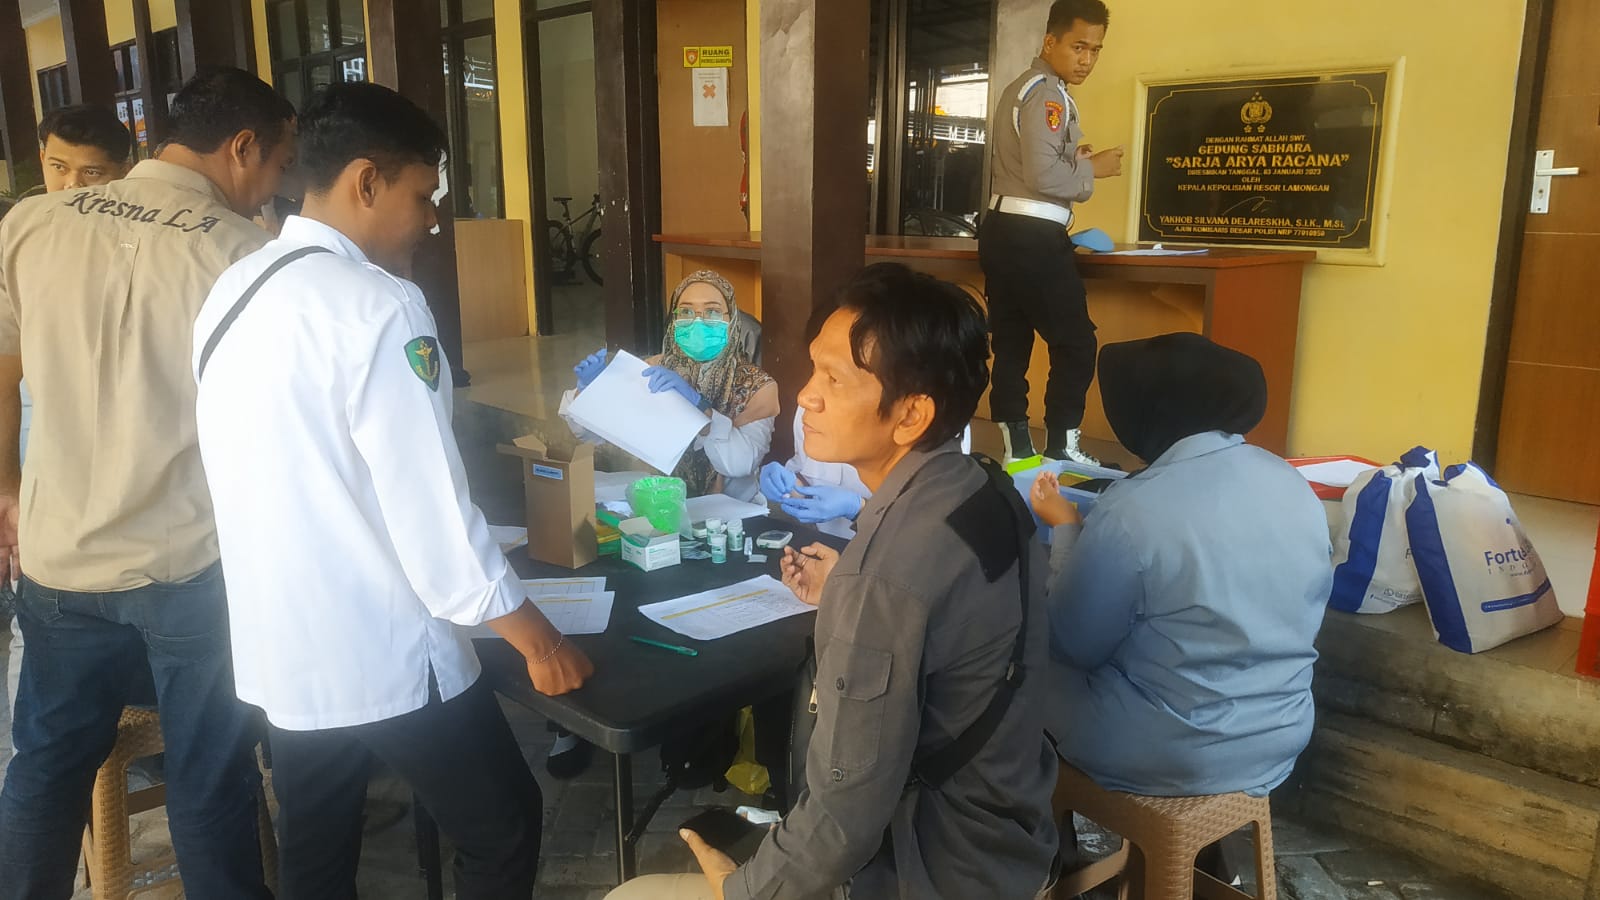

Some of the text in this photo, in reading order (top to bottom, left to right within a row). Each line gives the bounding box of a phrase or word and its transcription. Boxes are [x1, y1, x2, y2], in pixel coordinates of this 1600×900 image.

[1198, 143, 1312, 155] GEDUNG SABHARA
[1225, 155, 1267, 168] ARYA
[1177, 184, 1206, 192] KEPALA
[64, 191, 162, 224] Kresna
[162, 208, 192, 229] L
[1160, 215, 1193, 224] YAKHOB
[1194, 216, 1229, 225] SILVANA
